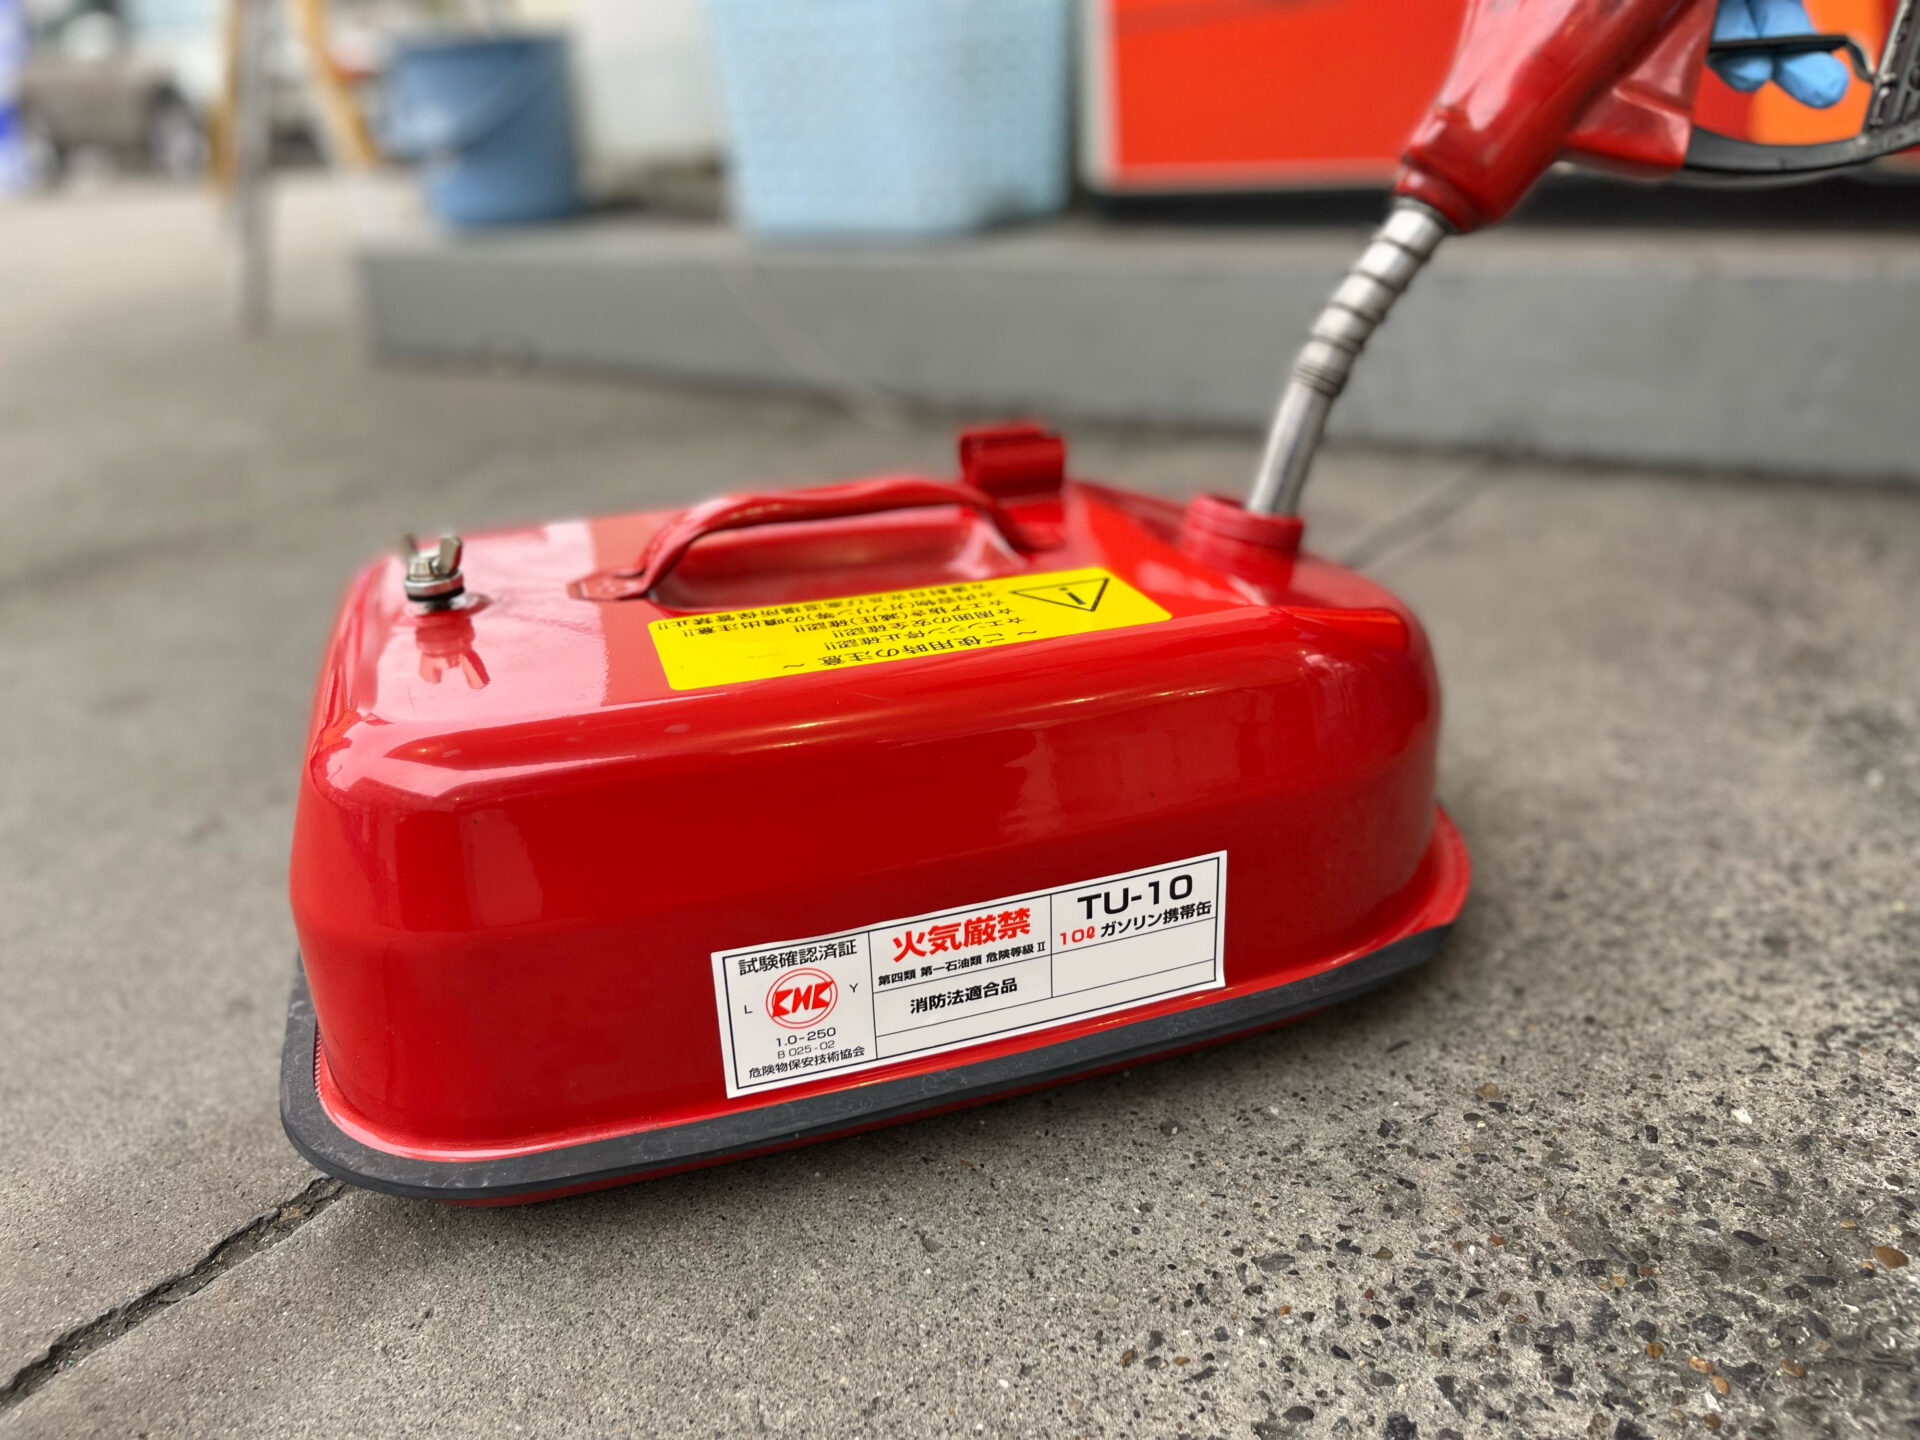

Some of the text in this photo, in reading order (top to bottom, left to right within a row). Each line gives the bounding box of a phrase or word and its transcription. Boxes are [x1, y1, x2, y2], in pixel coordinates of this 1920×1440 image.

[1077, 874, 1193, 920] TU-10
[892, 907, 1031, 963] 火気厳禁
[1100, 900, 1212, 938] ガソリン携帯缶
[738, 939, 857, 976] 試験確認済証
[849, 983, 858, 993] Y
[910, 977, 1018, 1015] 消防法適合品
[744, 1005, 753, 1014] L
[776, 1026, 837, 1047] 1.0-250
[749, 1045, 865, 1079] 危険物保安技術協会
